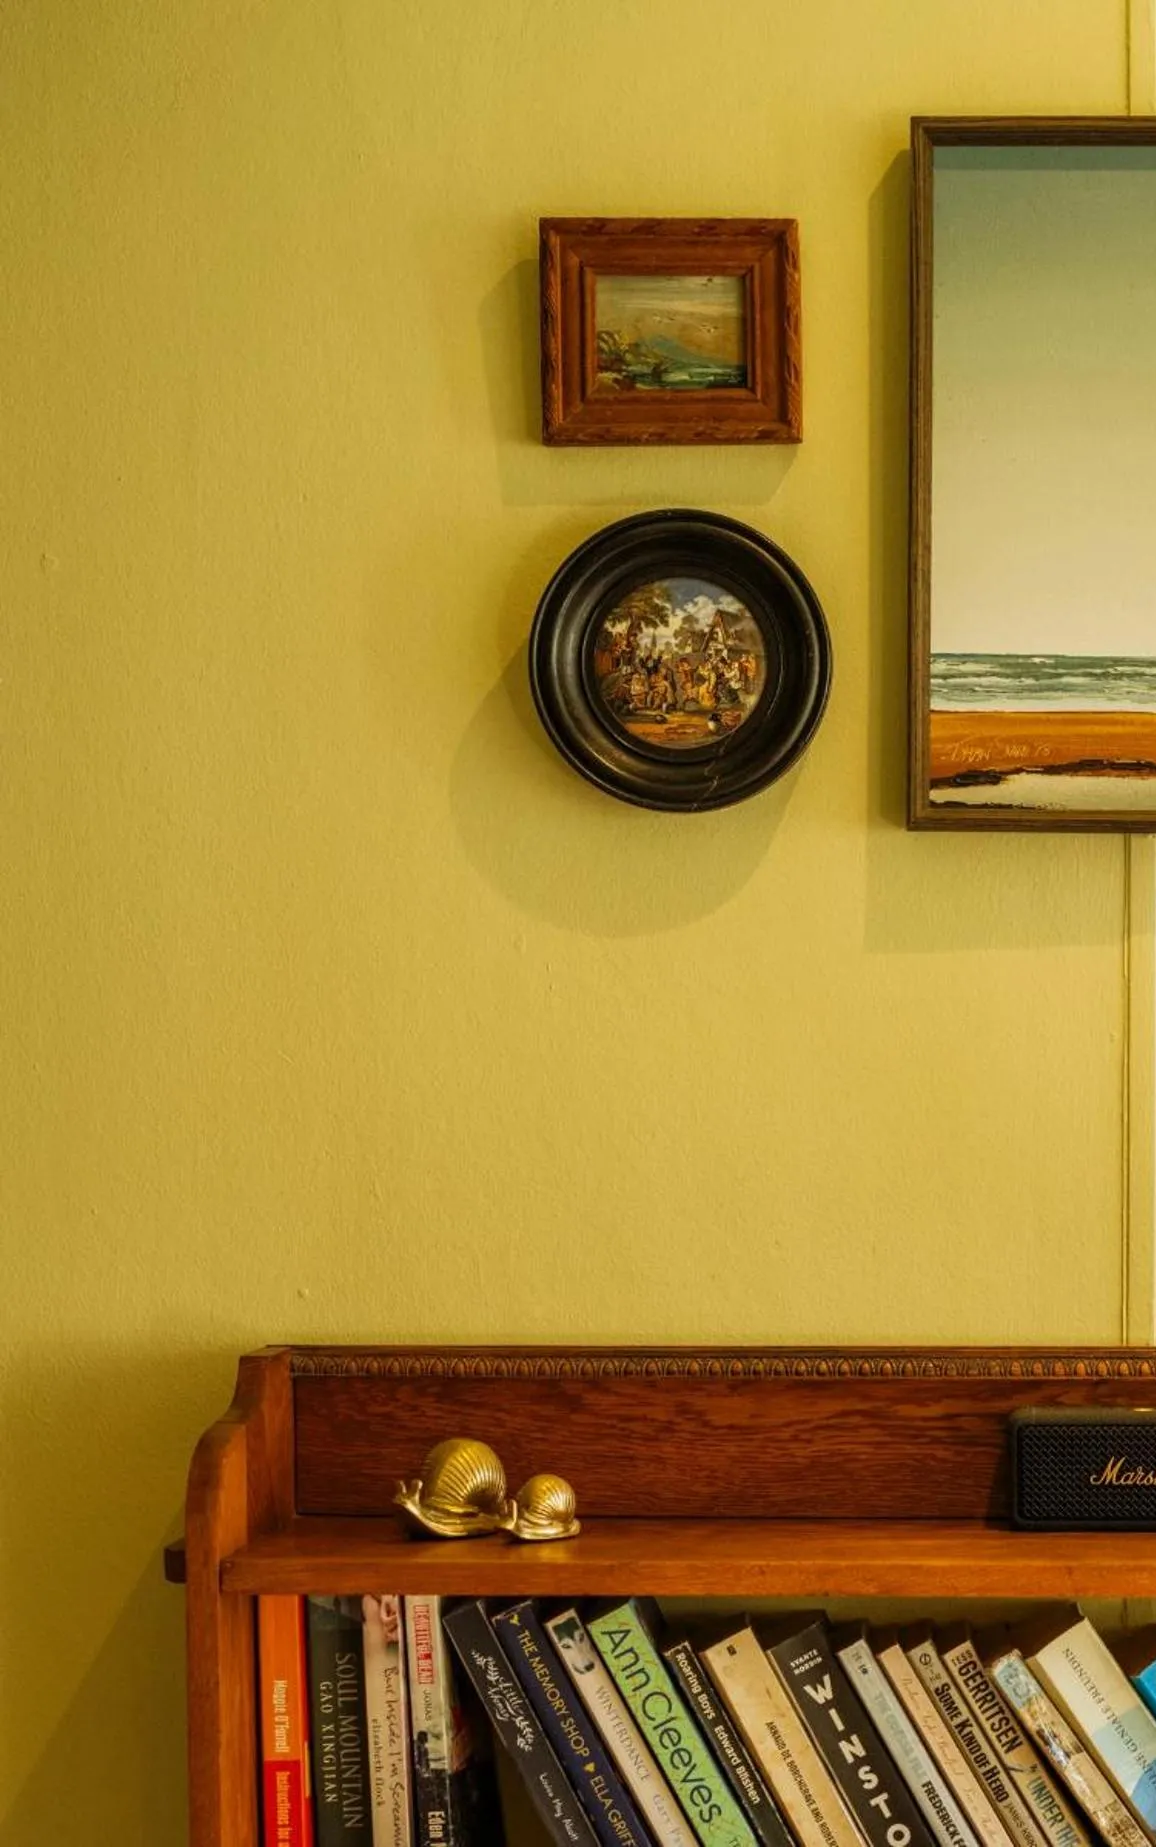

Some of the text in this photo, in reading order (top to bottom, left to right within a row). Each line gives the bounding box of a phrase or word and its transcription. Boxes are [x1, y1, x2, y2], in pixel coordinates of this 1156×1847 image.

[272, 1679, 289, 1713] Maggie
[932, 1680, 965, 1721] SOME
[1060, 1644, 1106, 1706] FREUNDIN
[385, 1698, 403, 1747] Inside
[422, 1689, 433, 1721] JONAS
[592, 1682, 652, 1785] WINTERDANCE
[598, 1618, 731, 1825] Ann Cleeves
[672, 1651, 704, 1695] Roaring
[695, 1692, 718, 1720] Boys
[712, 1724, 742, 1766] Edward
[955, 1658, 1023, 1755] GERRITSEN
[319, 1681, 337, 1803] GAO XINGJIAN
[334, 1652, 363, 1828] SOUL MOUNTAIN
[371, 1718, 383, 1772] elizabeth
[513, 1628, 639, 1847] THE MEMORY SHOP ELLA GRIFF
[803, 1673, 911, 1847] WINSTO
[953, 1717, 985, 1756] KIND
[972, 1751, 991, 1771] OF
[920, 1780, 960, 1840] FREDERICK
[981, 1764, 1012, 1803] HERO
[1025, 1774, 1066, 1828] UNDER
[427, 1810, 445, 1838] Eden
